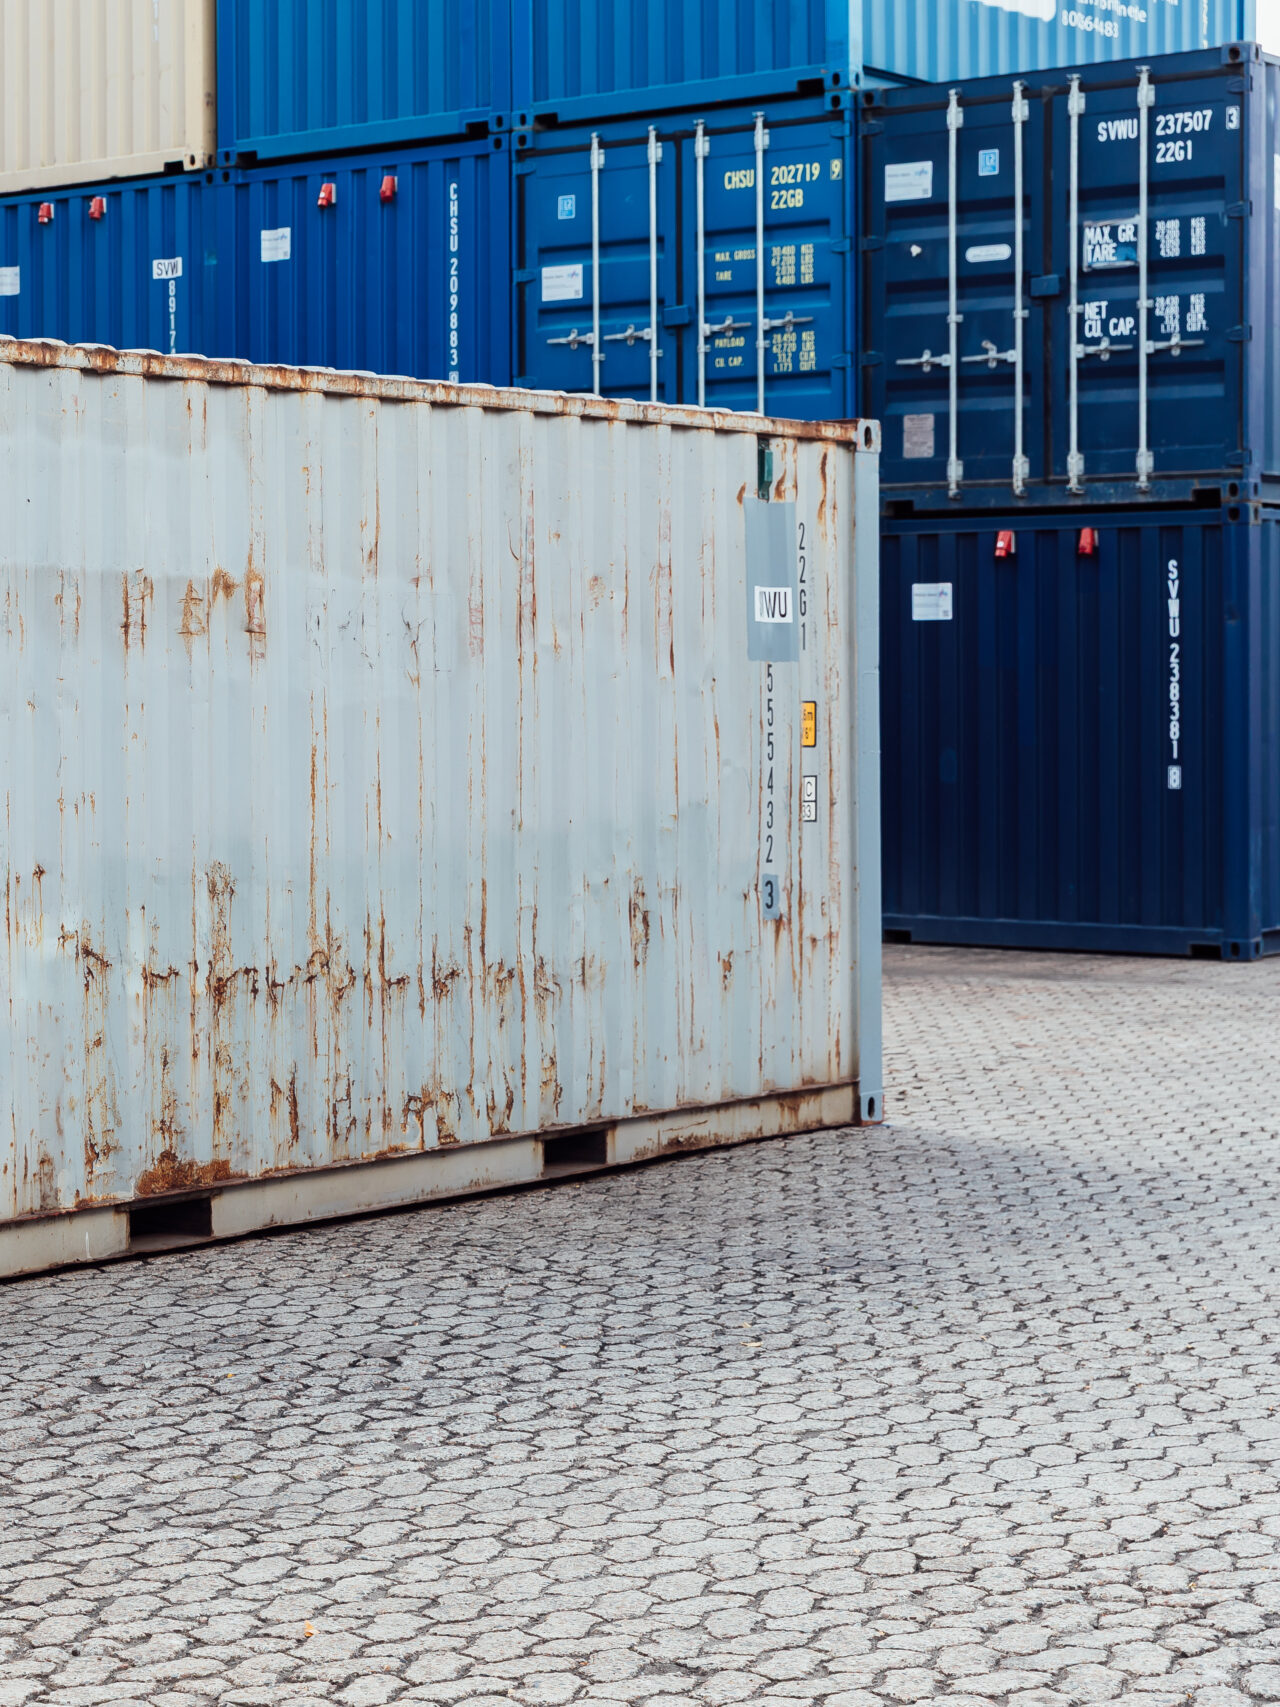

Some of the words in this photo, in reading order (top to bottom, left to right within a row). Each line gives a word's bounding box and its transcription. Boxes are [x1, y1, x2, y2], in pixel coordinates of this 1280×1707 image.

[1098, 118, 1138, 142] SVWU
[1156, 109, 1213, 136] 237507
[1227, 107, 1239, 129] 3
[1156, 140, 1193, 163] 22G1
[724, 169, 754, 190] CHSU
[771, 162, 820, 185] 202719
[831, 159, 841, 179] 9
[450, 182, 459, 252] CHSU
[1087, 243, 1117, 262] TARE
[716, 270, 732, 281] TARE
[450, 257, 459, 366] 209883
[1085, 301, 1108, 320] NET
[715, 337, 745, 348] PAYLOAD
[798, 522, 807, 650] 22G1
[1167, 559, 1180, 637] SVWU
[1168, 642, 1180, 760] 238381
[766, 663, 774, 863] 555432
[1169, 766, 1180, 788] 8
[765, 880, 774, 910] 3
